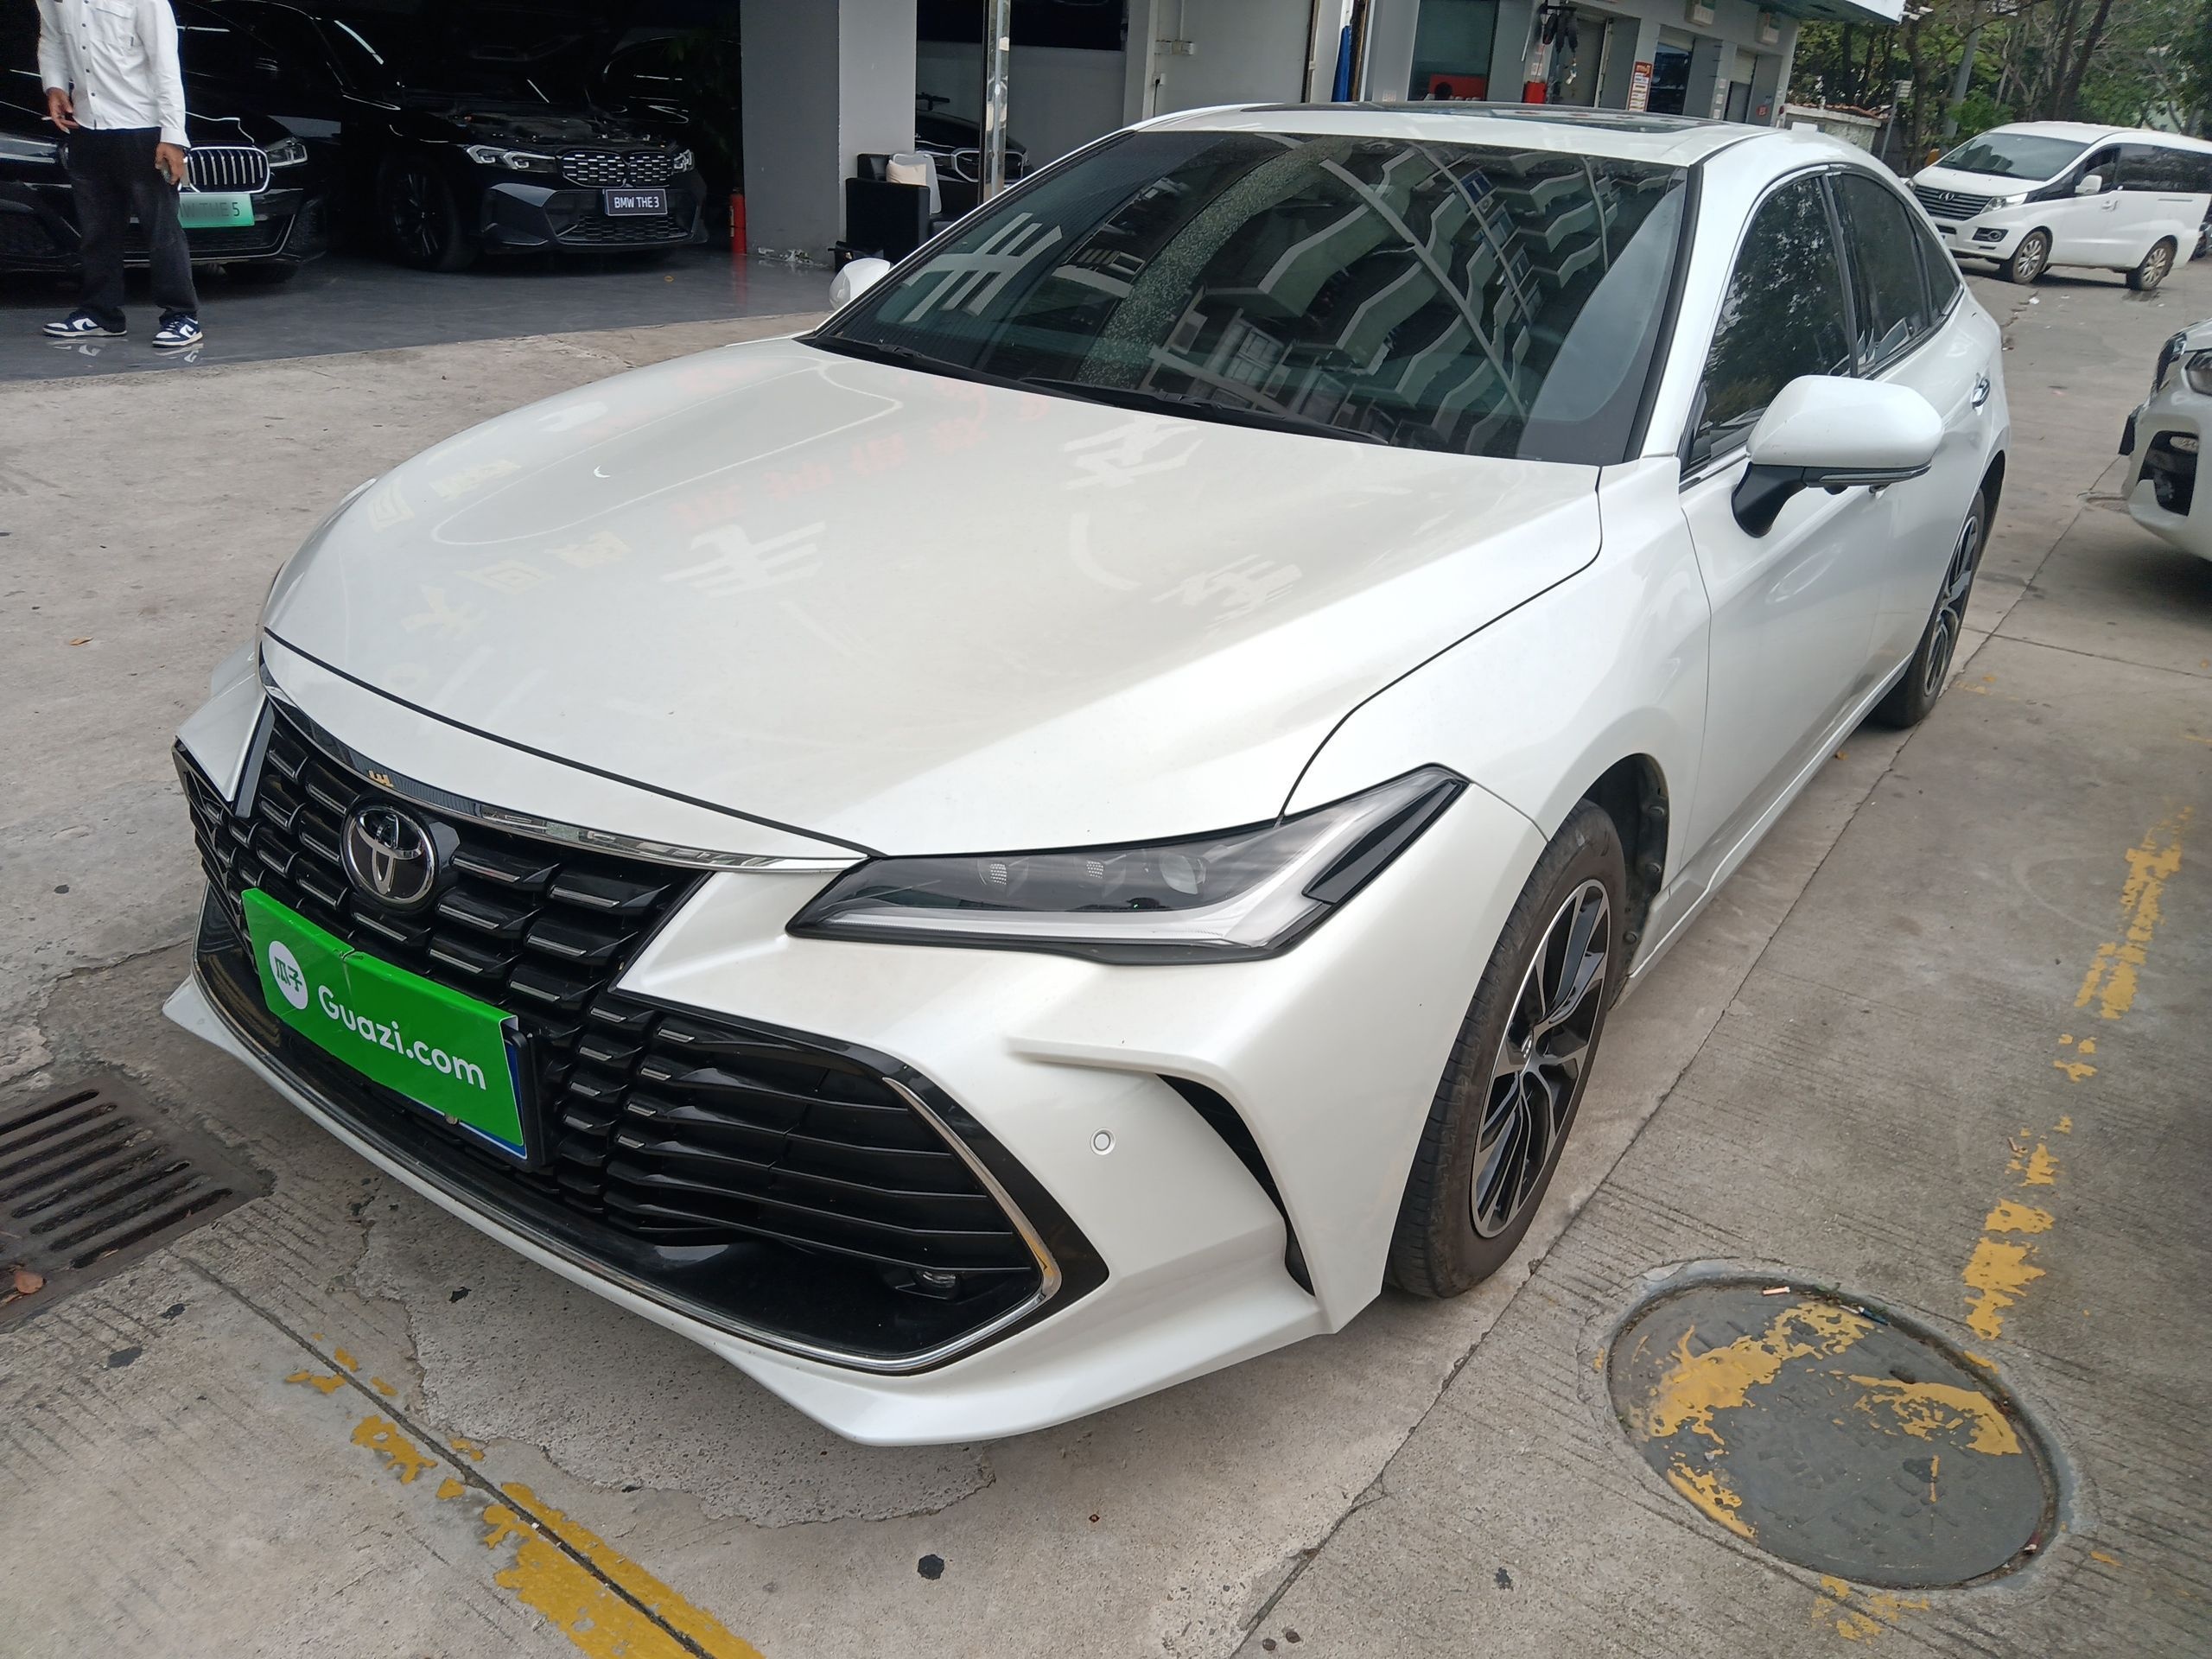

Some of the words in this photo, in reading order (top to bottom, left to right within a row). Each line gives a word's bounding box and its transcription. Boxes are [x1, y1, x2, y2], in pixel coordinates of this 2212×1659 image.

[199, 202, 230, 217] THE
[232, 201, 240, 217] 5
[613, 196, 634, 208] BMW
[636, 196, 654, 208] THE
[654, 196, 660, 208] 3
[273, 956, 303, 993] 瓜子
[318, 984, 486, 1091] Guazi.com
